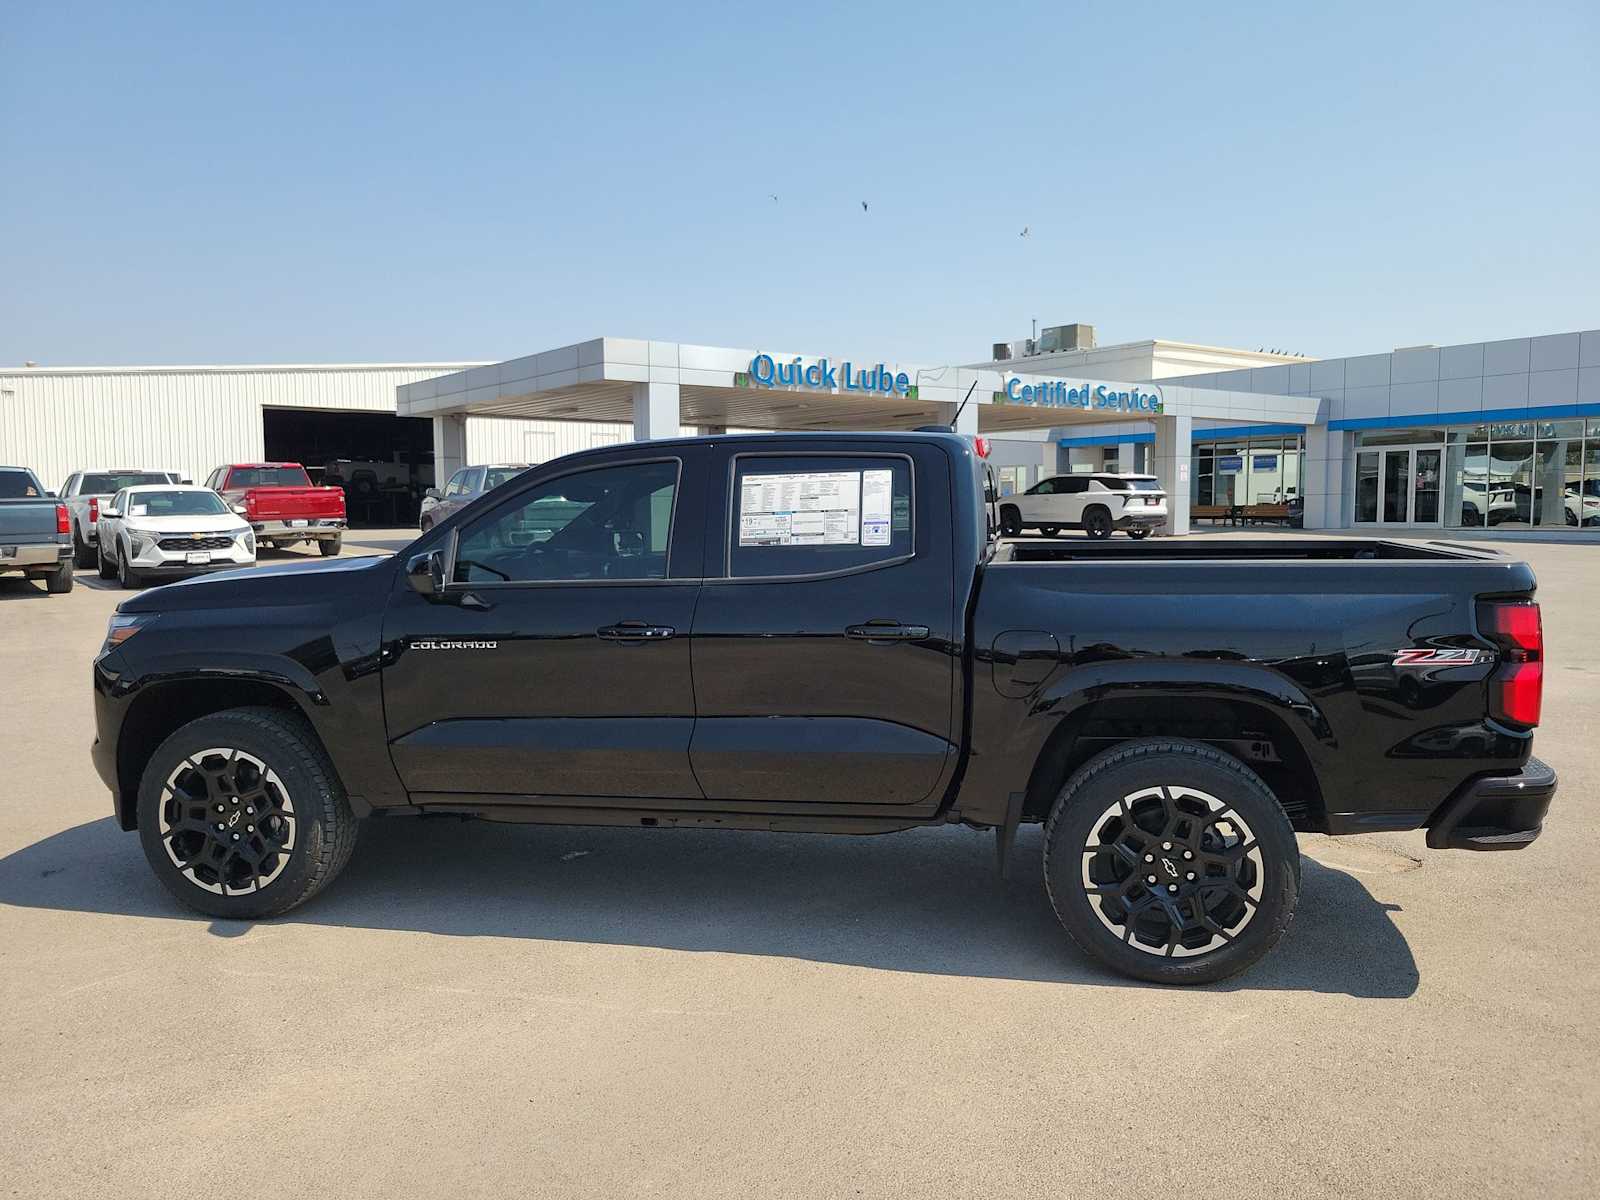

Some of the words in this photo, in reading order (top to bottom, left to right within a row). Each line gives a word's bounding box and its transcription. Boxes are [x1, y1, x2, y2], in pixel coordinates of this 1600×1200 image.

[750, 354, 838, 388] Quick
[842, 362, 910, 393] Lube
[1007, 377, 1091, 406] Certified
[1096, 385, 1159, 410] Service
[410, 641, 497, 649] COLORADO
[1392, 649, 1480, 665] Z71
